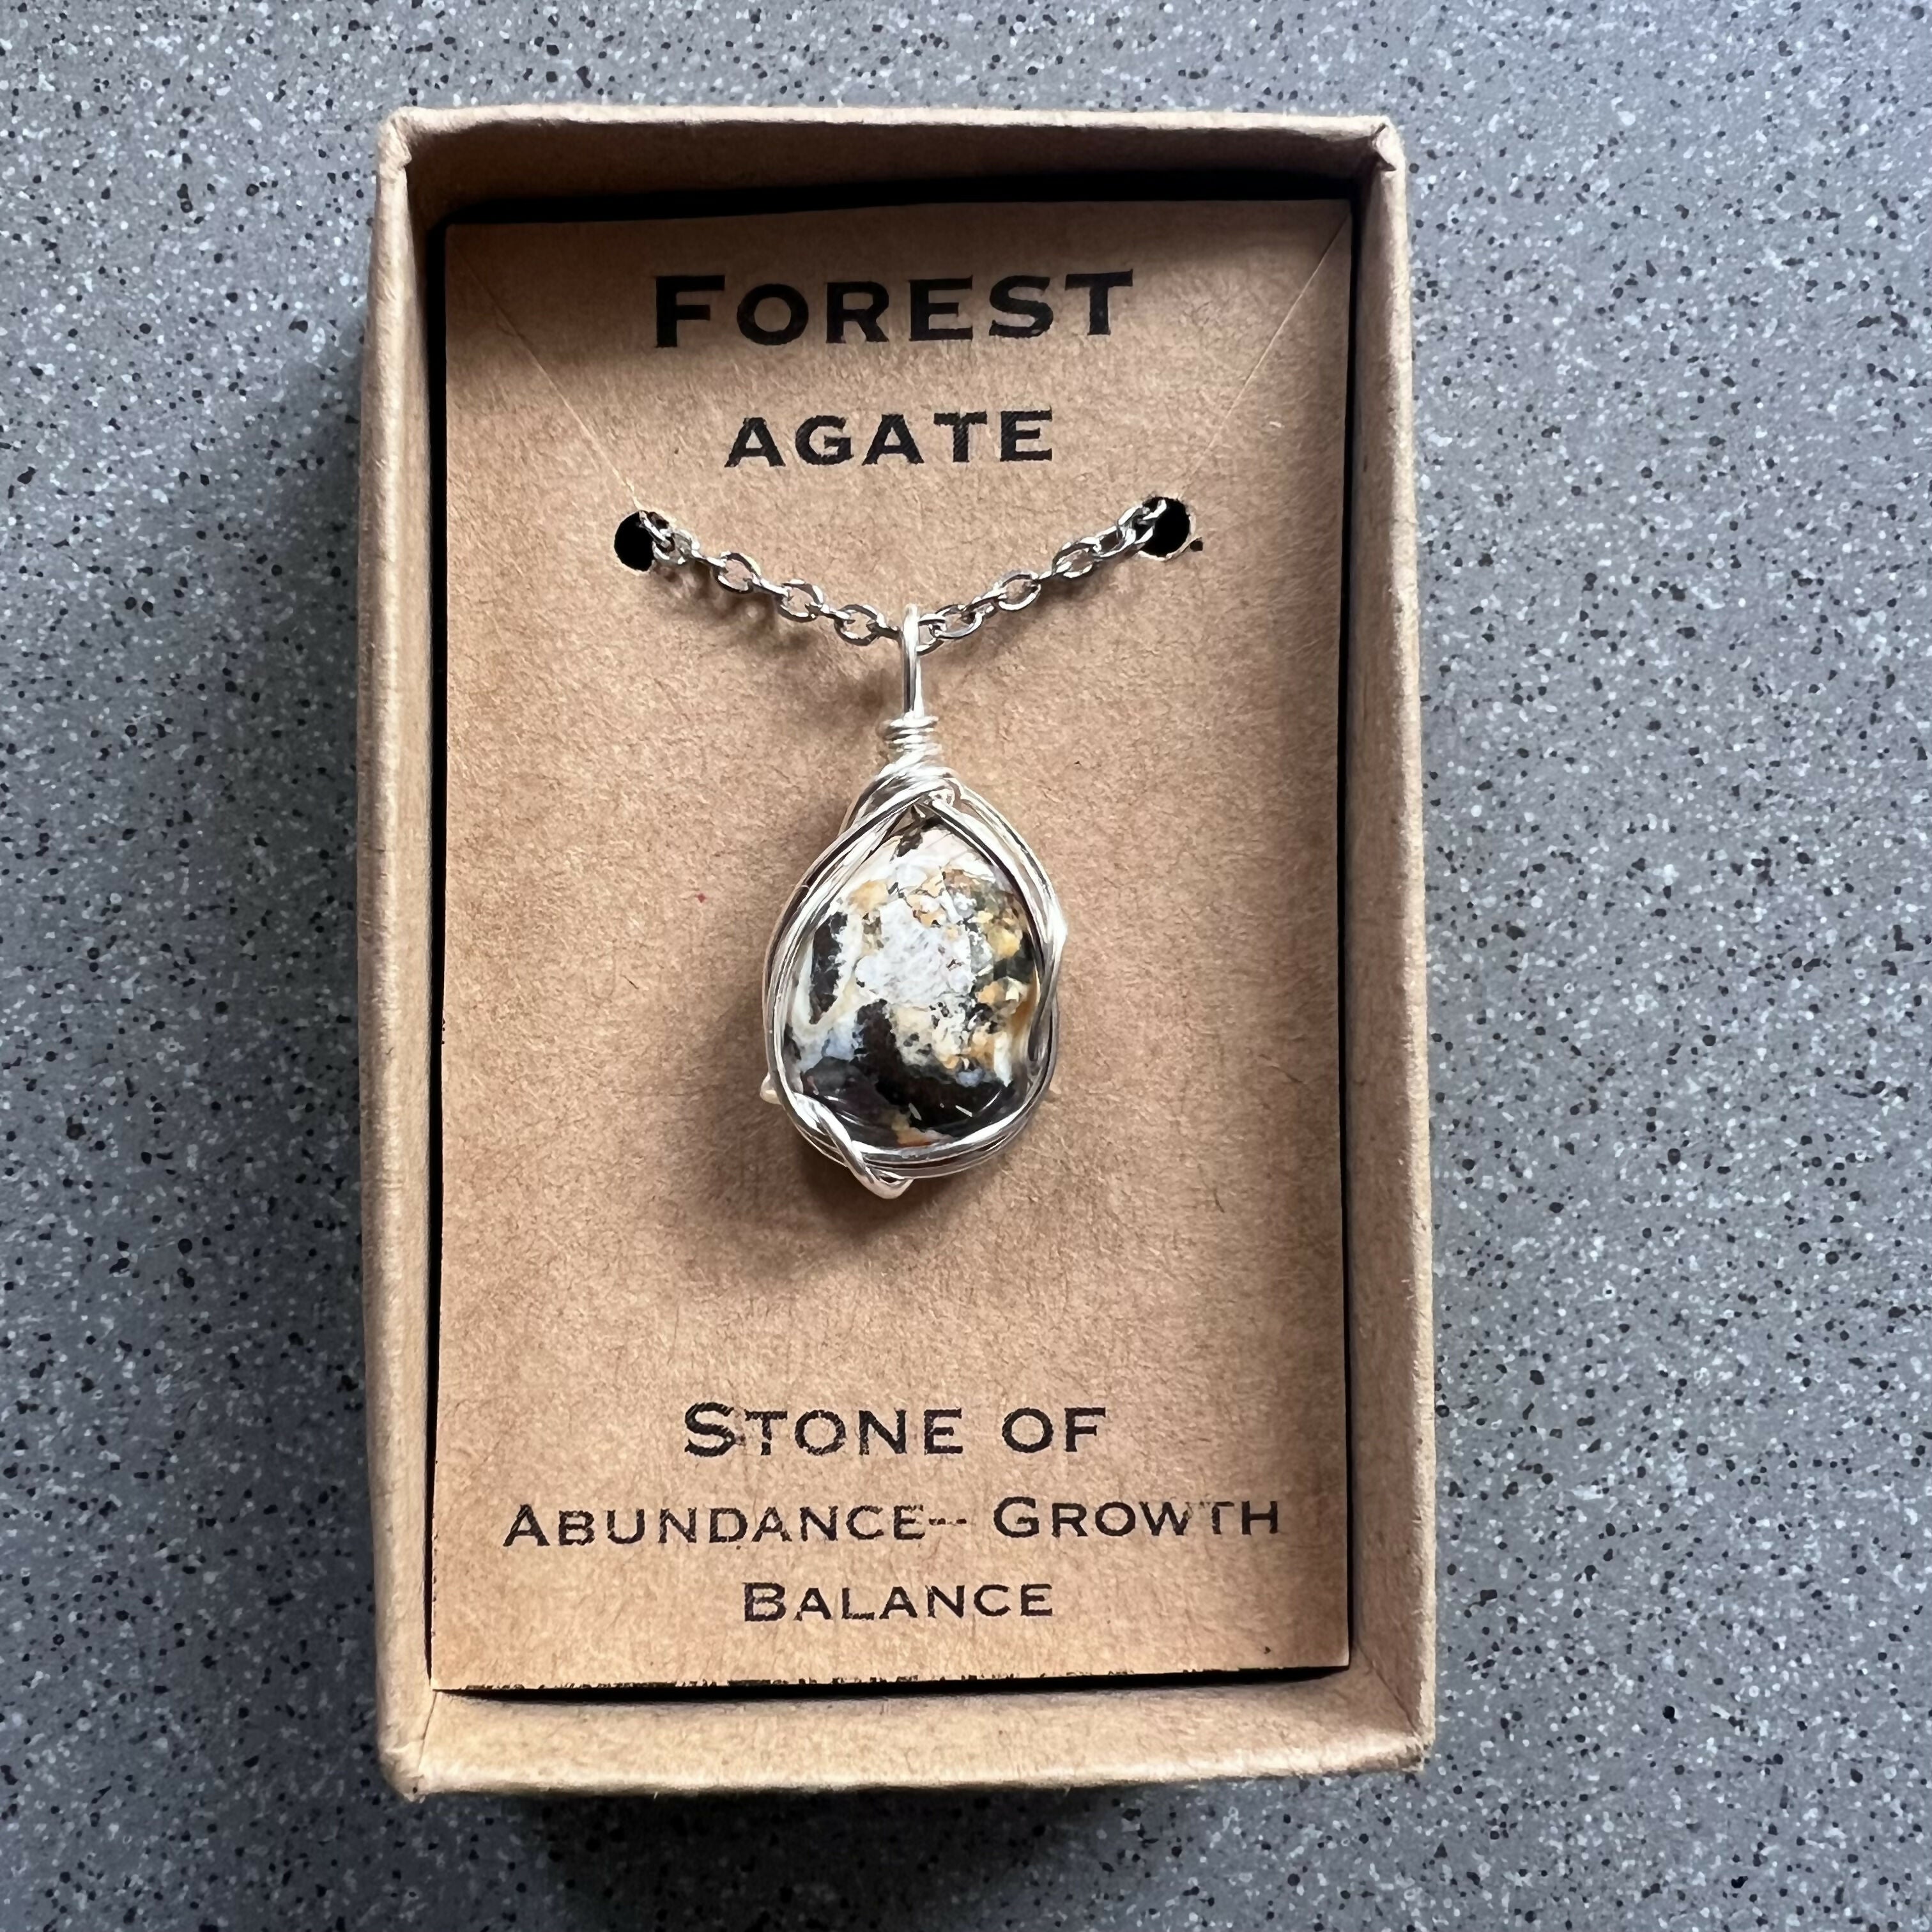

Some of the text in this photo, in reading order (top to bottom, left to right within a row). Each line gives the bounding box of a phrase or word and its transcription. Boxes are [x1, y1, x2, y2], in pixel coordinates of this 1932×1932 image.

[655, 269, 1134, 349] FOREST
[724, 405, 1054, 468] AGATE
[684, 1401, 1107, 1457] STONE OF
[993, 1496, 1280, 1539] GROWTH
[743, 1581, 1054, 1622] BALANCE
